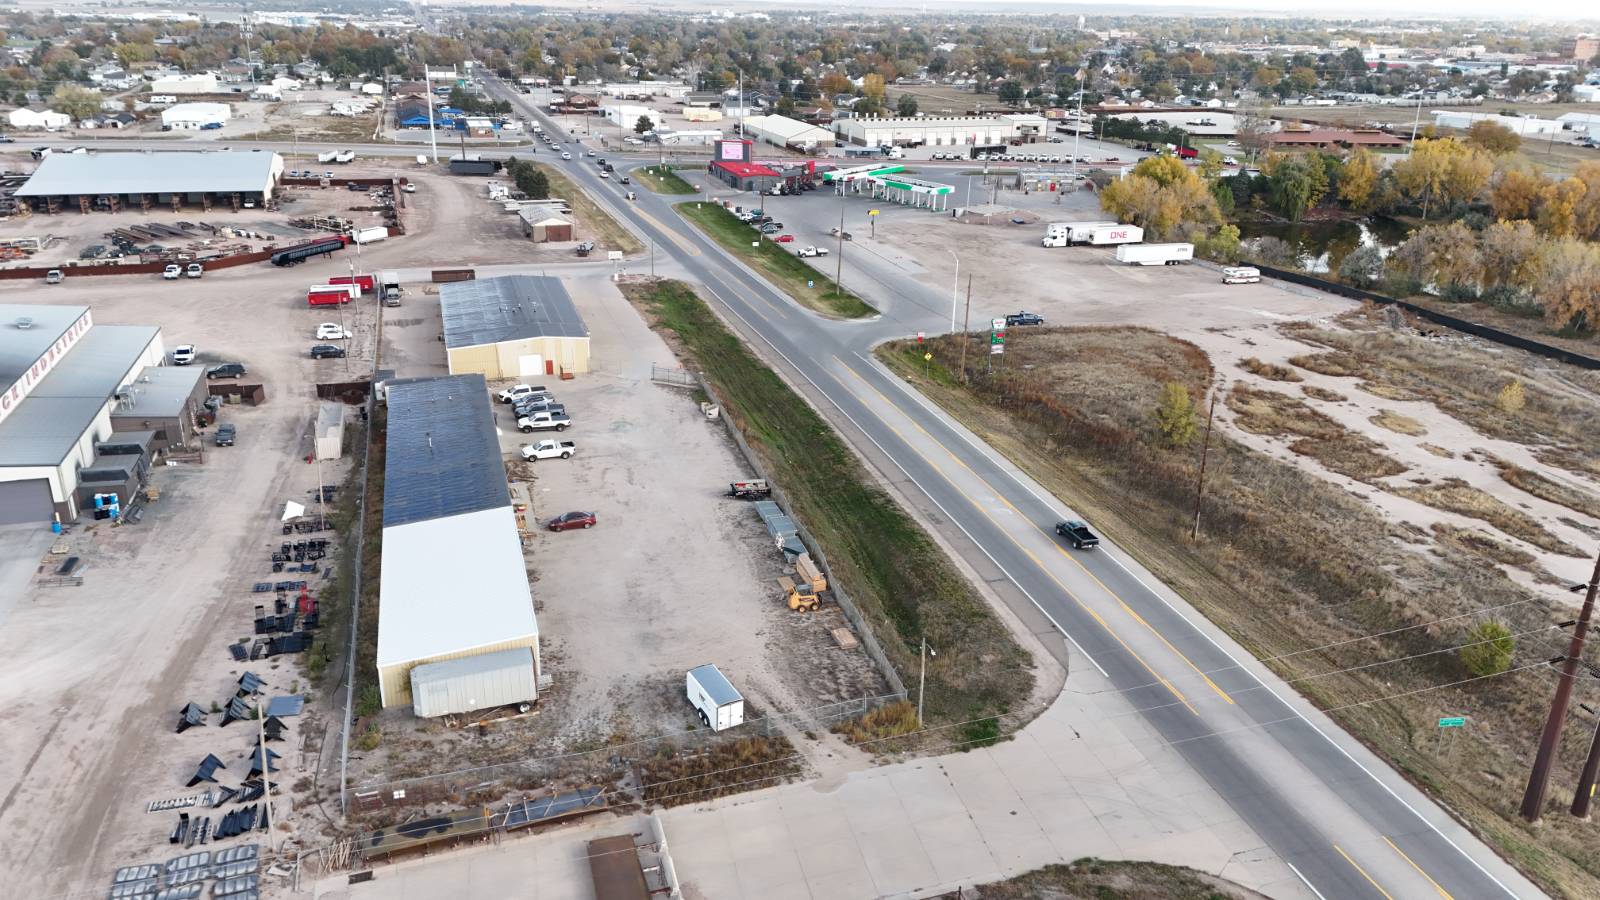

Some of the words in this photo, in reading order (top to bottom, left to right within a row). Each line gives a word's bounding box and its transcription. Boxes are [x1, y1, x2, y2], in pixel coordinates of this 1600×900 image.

[1110, 231, 1128, 239] ONE
[0, 385, 19, 412] CK
[26, 315, 88, 386] INDUSTRIES
